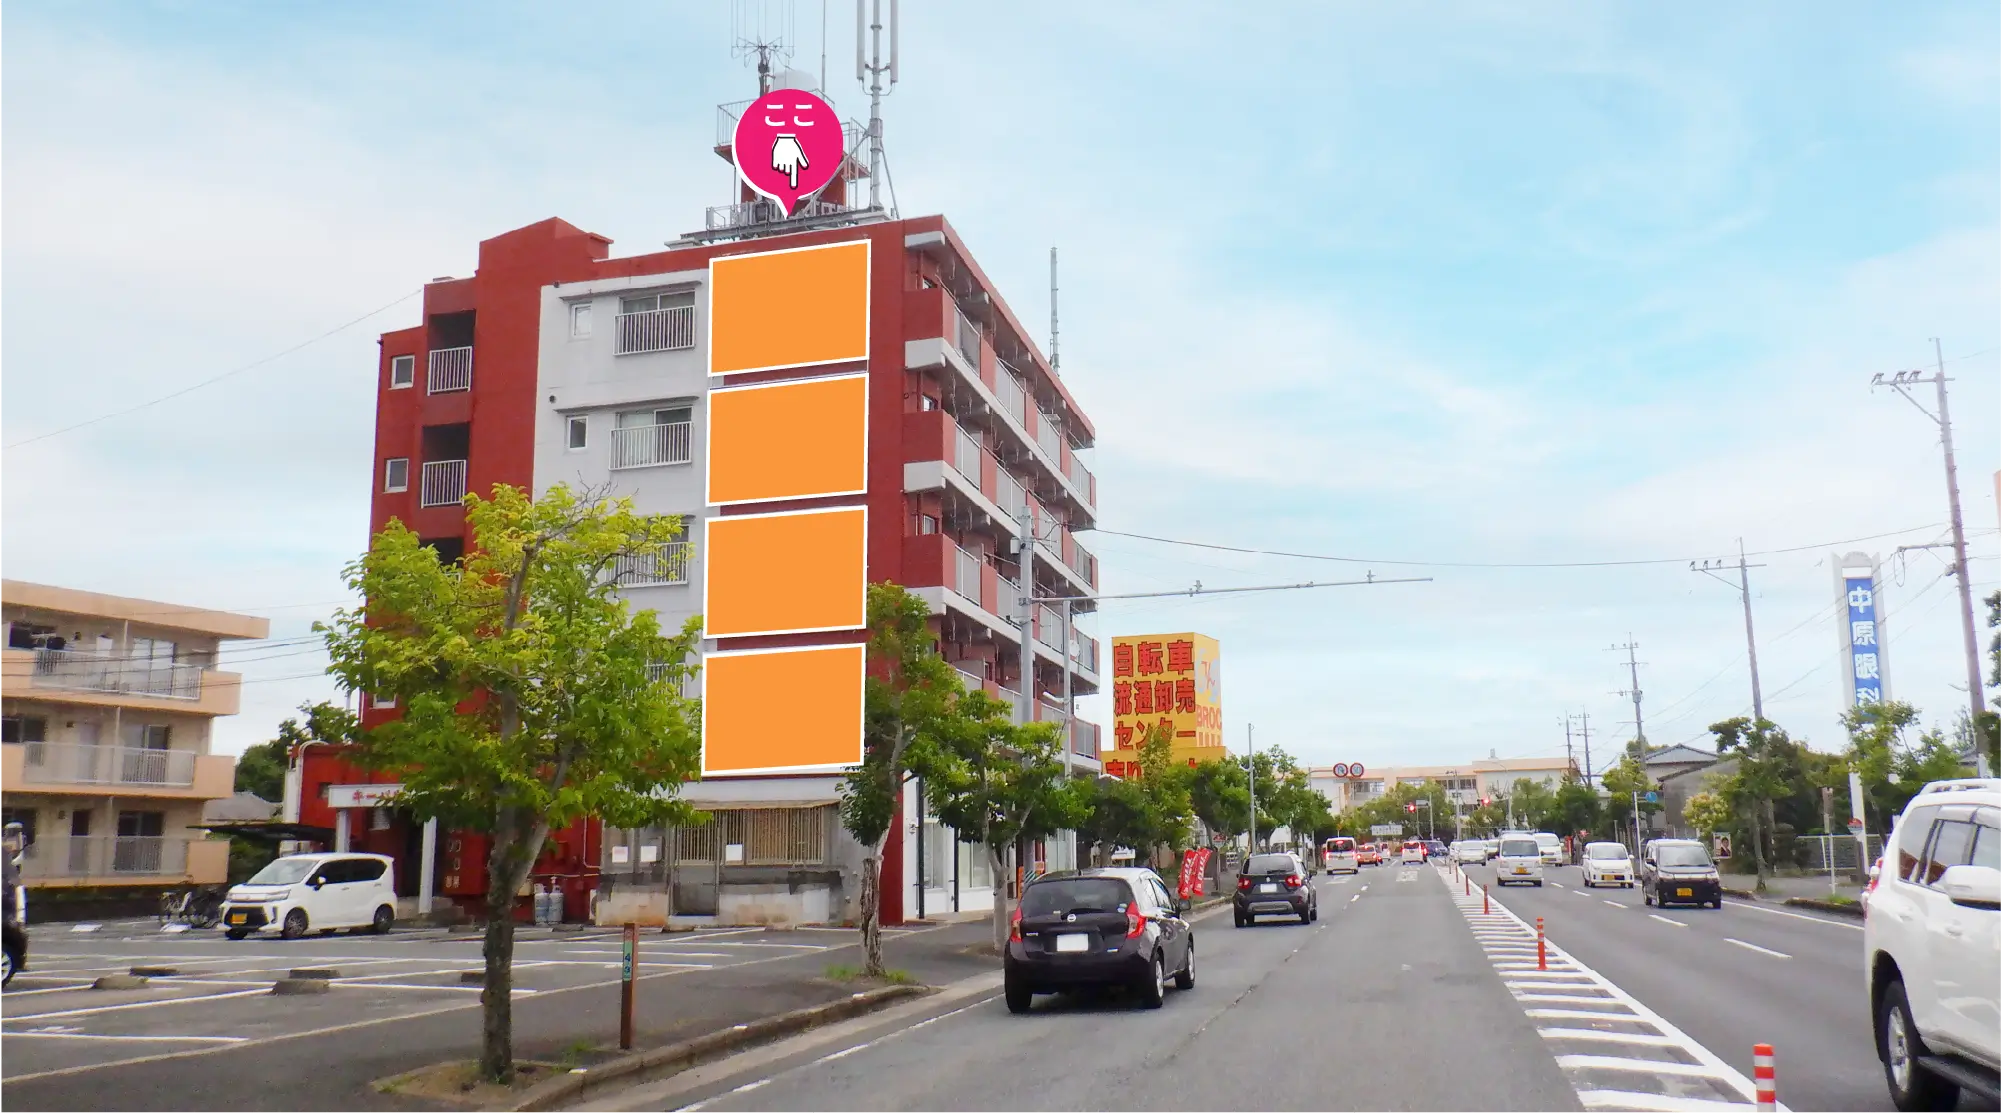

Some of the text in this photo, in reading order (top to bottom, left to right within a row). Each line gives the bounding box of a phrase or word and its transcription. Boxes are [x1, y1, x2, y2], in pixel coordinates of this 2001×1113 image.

[1113, 639, 1195, 678] 自転車
[1113, 677, 1196, 717] 流通卸売
